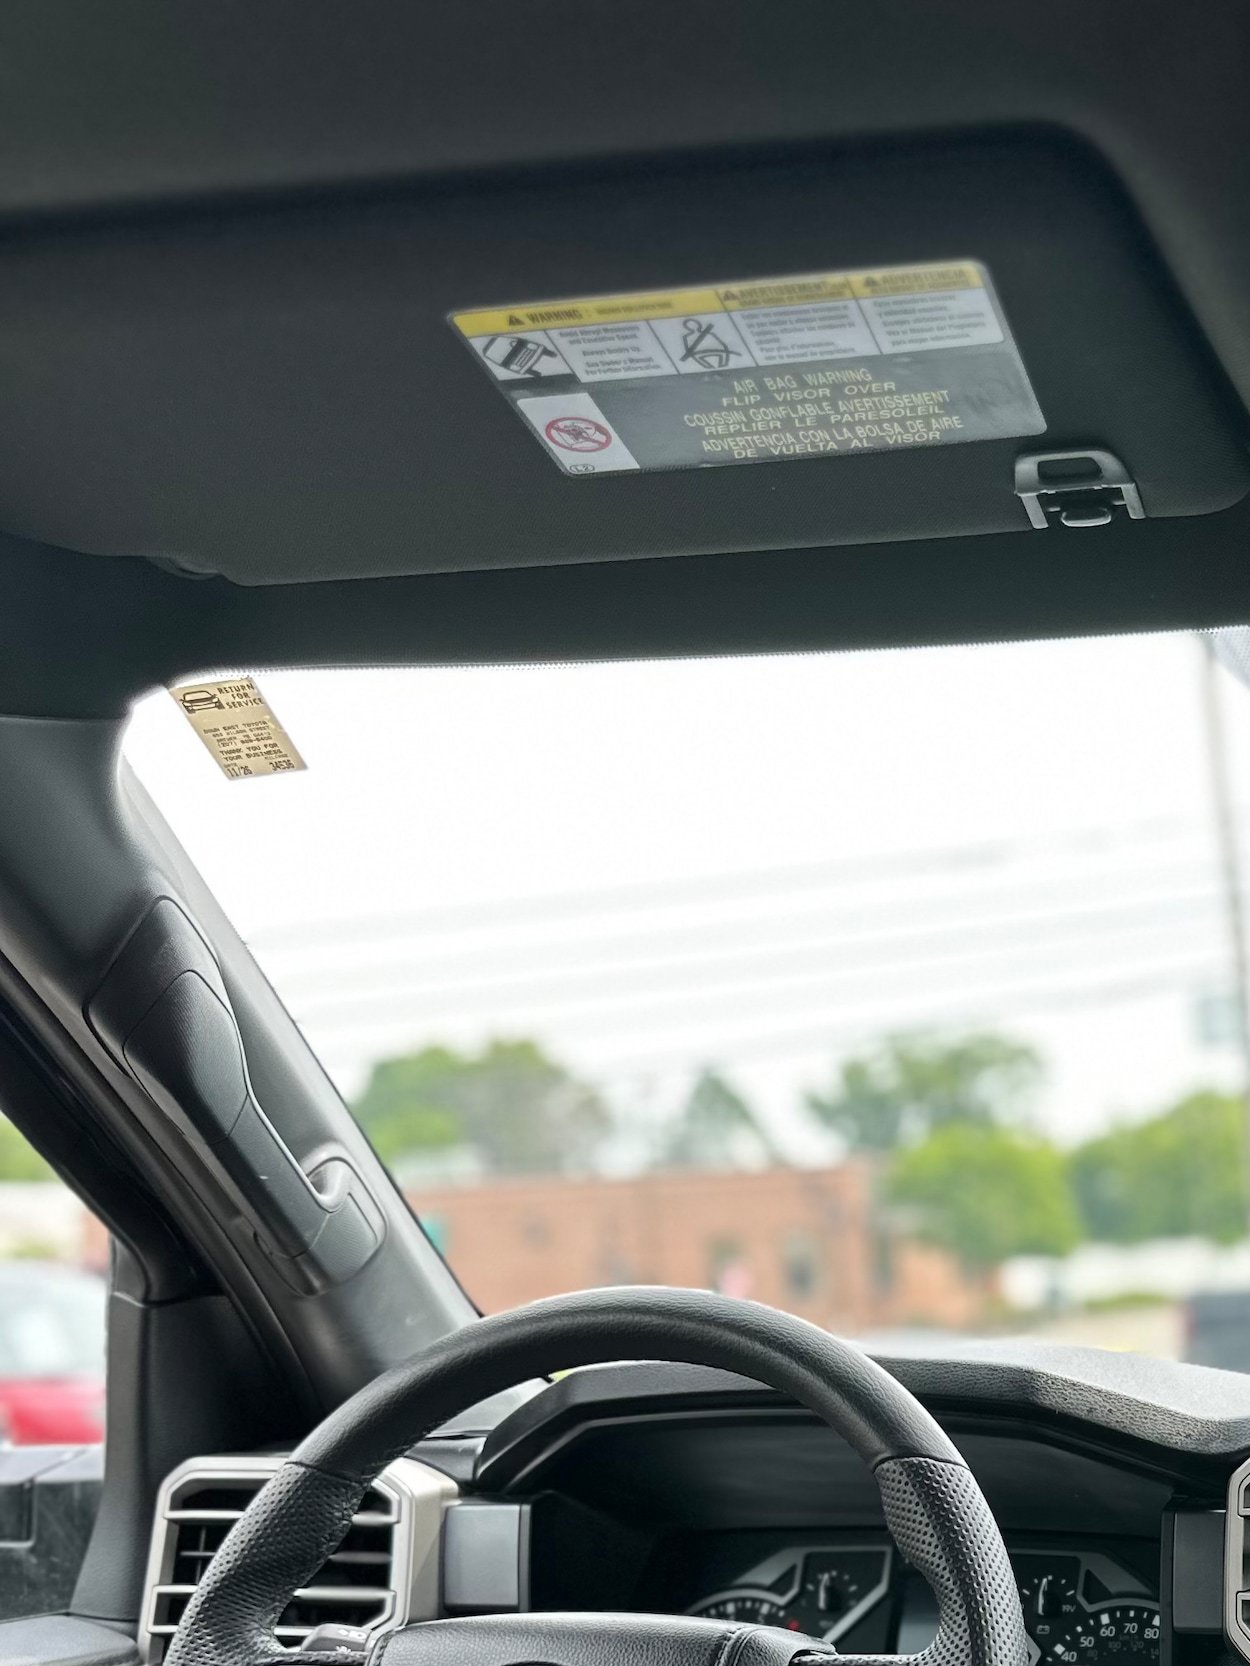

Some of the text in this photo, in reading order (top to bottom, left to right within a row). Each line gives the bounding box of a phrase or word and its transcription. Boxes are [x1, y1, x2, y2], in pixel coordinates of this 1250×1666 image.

[525, 309, 583, 324] WARNING
[721, 381, 897, 407] FLIP VISOR OVER
[733, 368, 872, 394] AIR BAG WARNING
[683, 390, 951, 428] COUSSIN GONFLABLE AVERTISSEMENT
[704, 404, 946, 436] REPLIER LE PARESOLEIL
[702, 415, 964, 452] ADVERTENCIA CON LA BOLSA DE AIRE
[734, 431, 942, 460] DE VUELTA AL VISOR
[217, 683, 255, 694] RETURN
[231, 692, 250, 700] FOR
[226, 698, 264, 708] SERVICE
[246, 749, 282, 758] BUSINESS
[1061, 1651, 1078, 1662] 40
[1079, 1636, 1094, 1648] 50
[1100, 1626, 1116, 1637] 60
[1123, 1622, 1138, 1634] 70
[1144, 1628, 1160, 1639] 80
